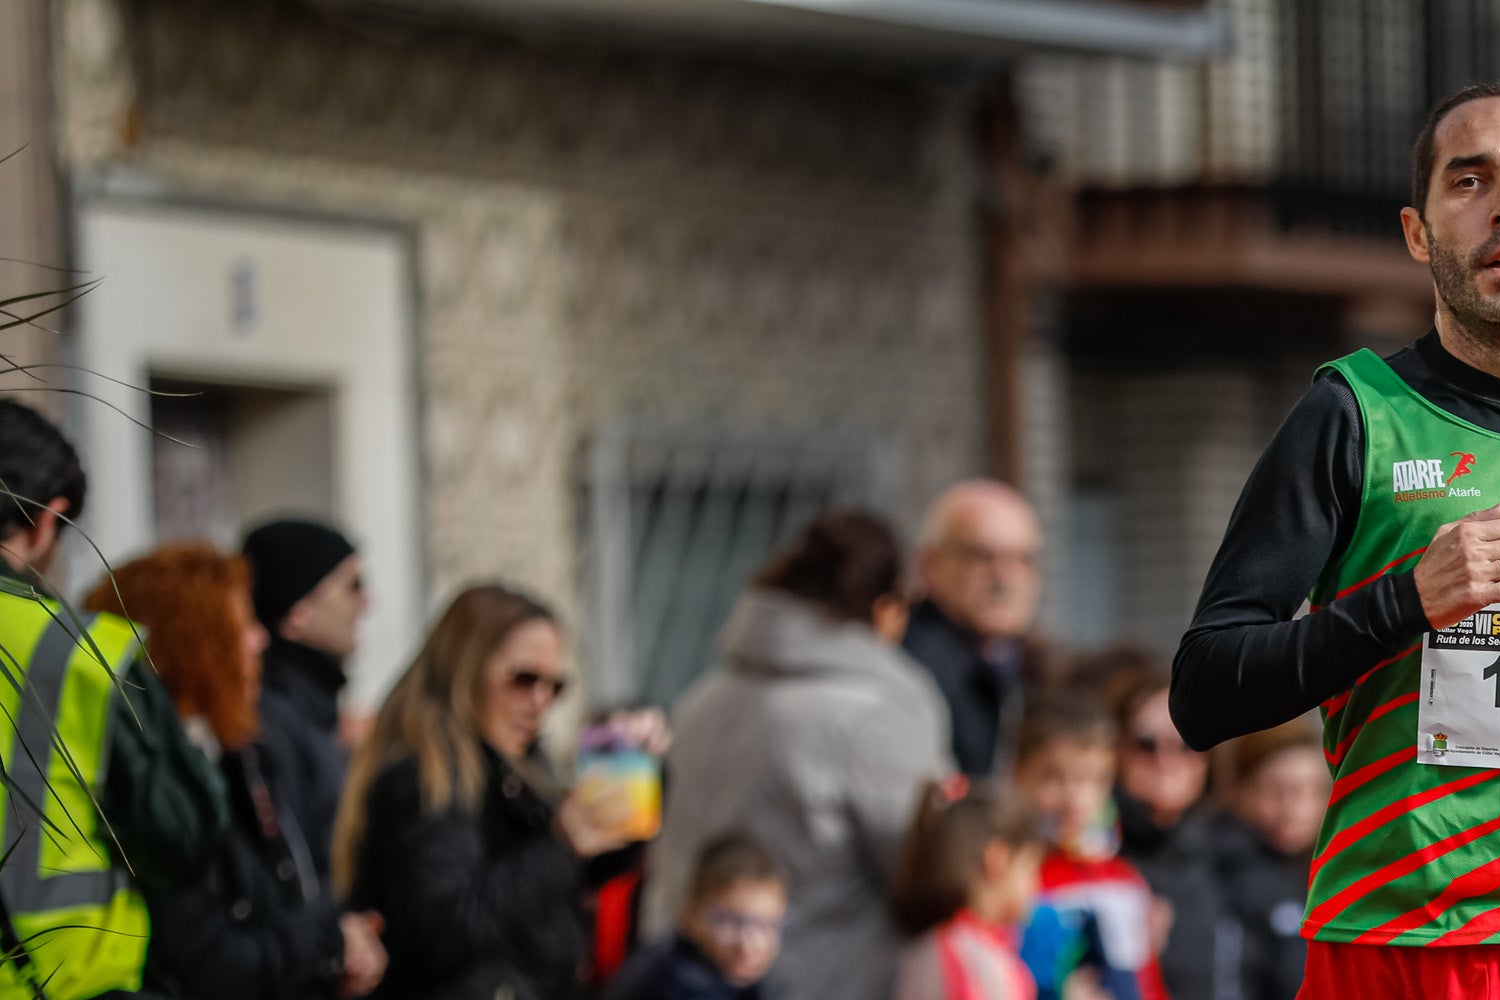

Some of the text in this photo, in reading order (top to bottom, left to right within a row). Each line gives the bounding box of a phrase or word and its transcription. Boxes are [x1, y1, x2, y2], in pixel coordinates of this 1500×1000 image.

[1392, 459, 1446, 493] ATARFE
[1394, 487, 1481, 503] Atletismo Atarfe
[1475, 613, 1492, 635] VII
[1436, 634, 1457, 644] Ruta
[1458, 635, 1470, 645] de
[1471, 635, 1486, 645] los
